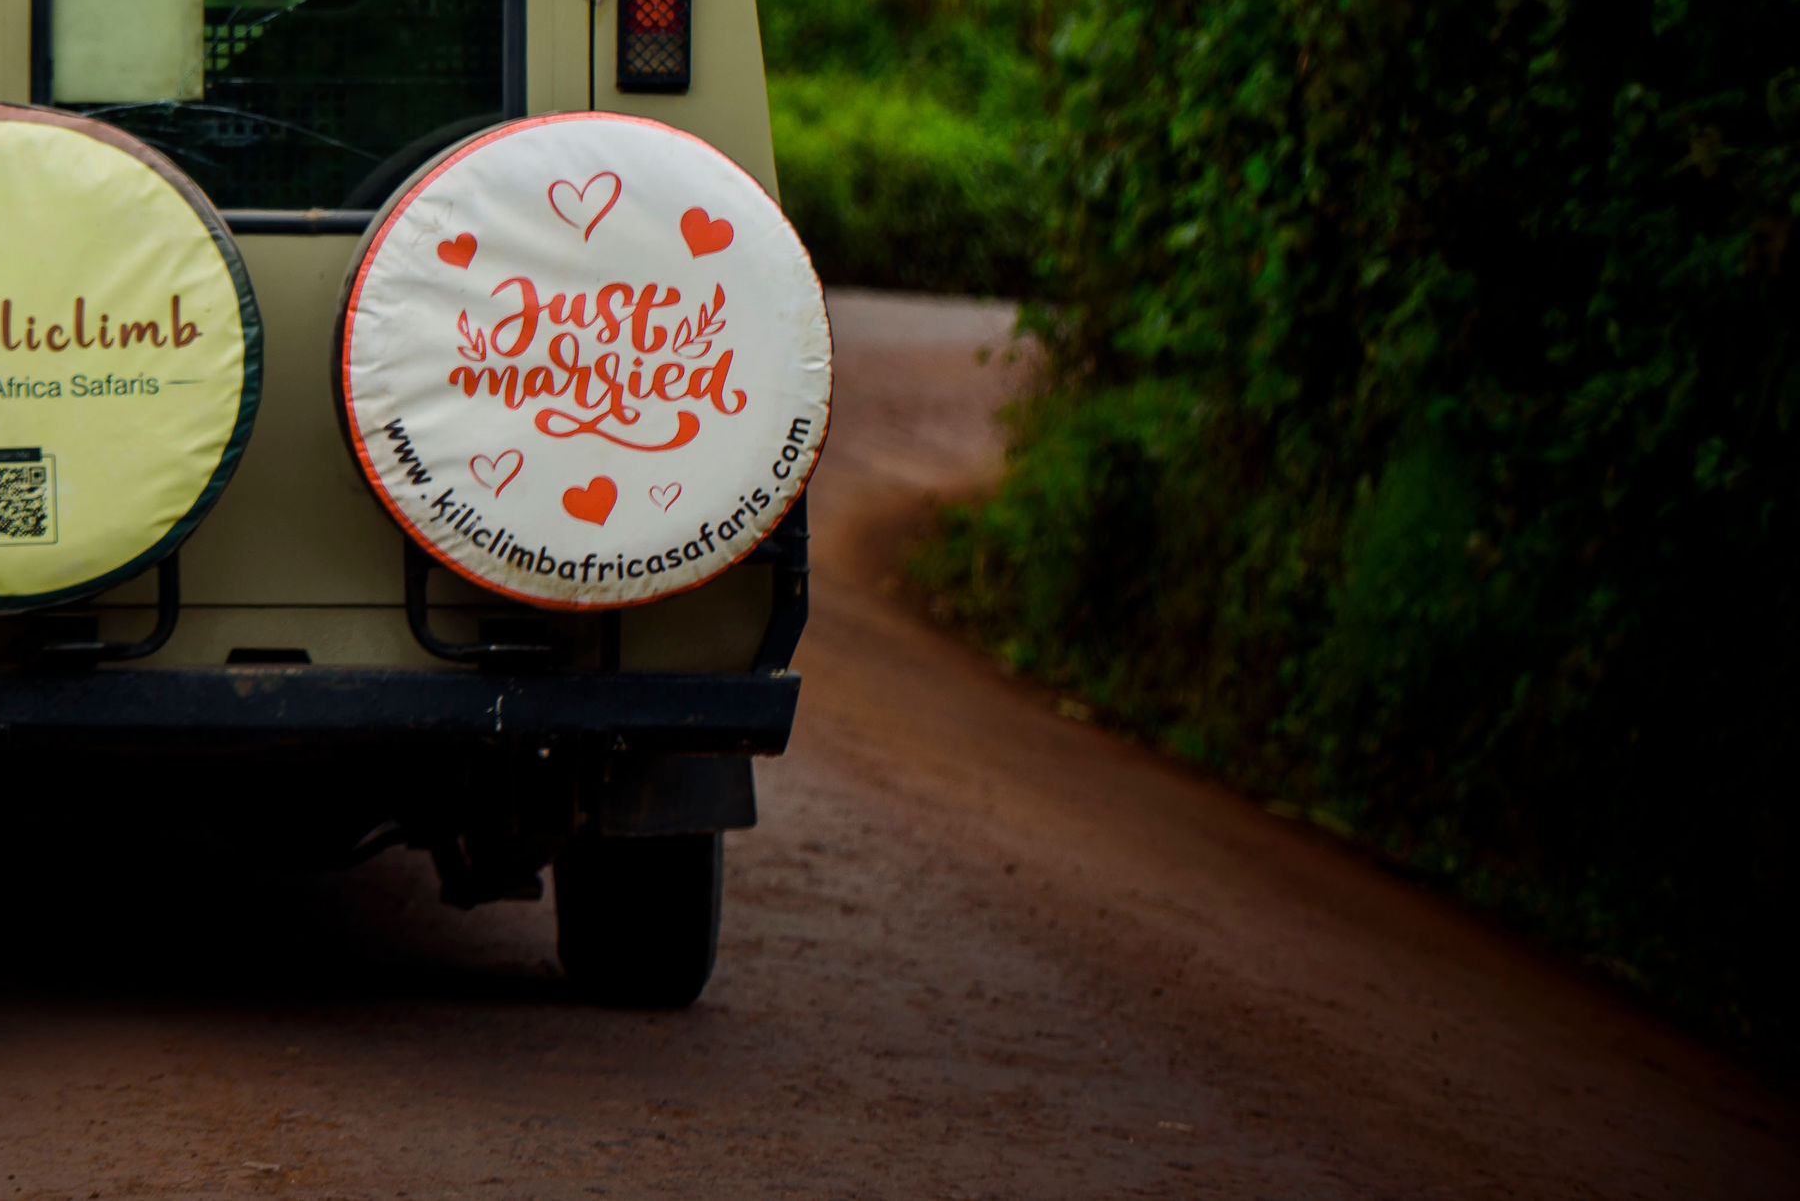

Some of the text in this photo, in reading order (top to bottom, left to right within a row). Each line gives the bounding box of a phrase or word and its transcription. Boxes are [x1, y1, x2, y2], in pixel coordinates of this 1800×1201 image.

[490, 276, 681, 358] Just
[71, 372, 160, 398] Safaris
[448, 333, 747, 452] married
[383, 416, 812, 584] www.kiliclimbafricasafaris.com
